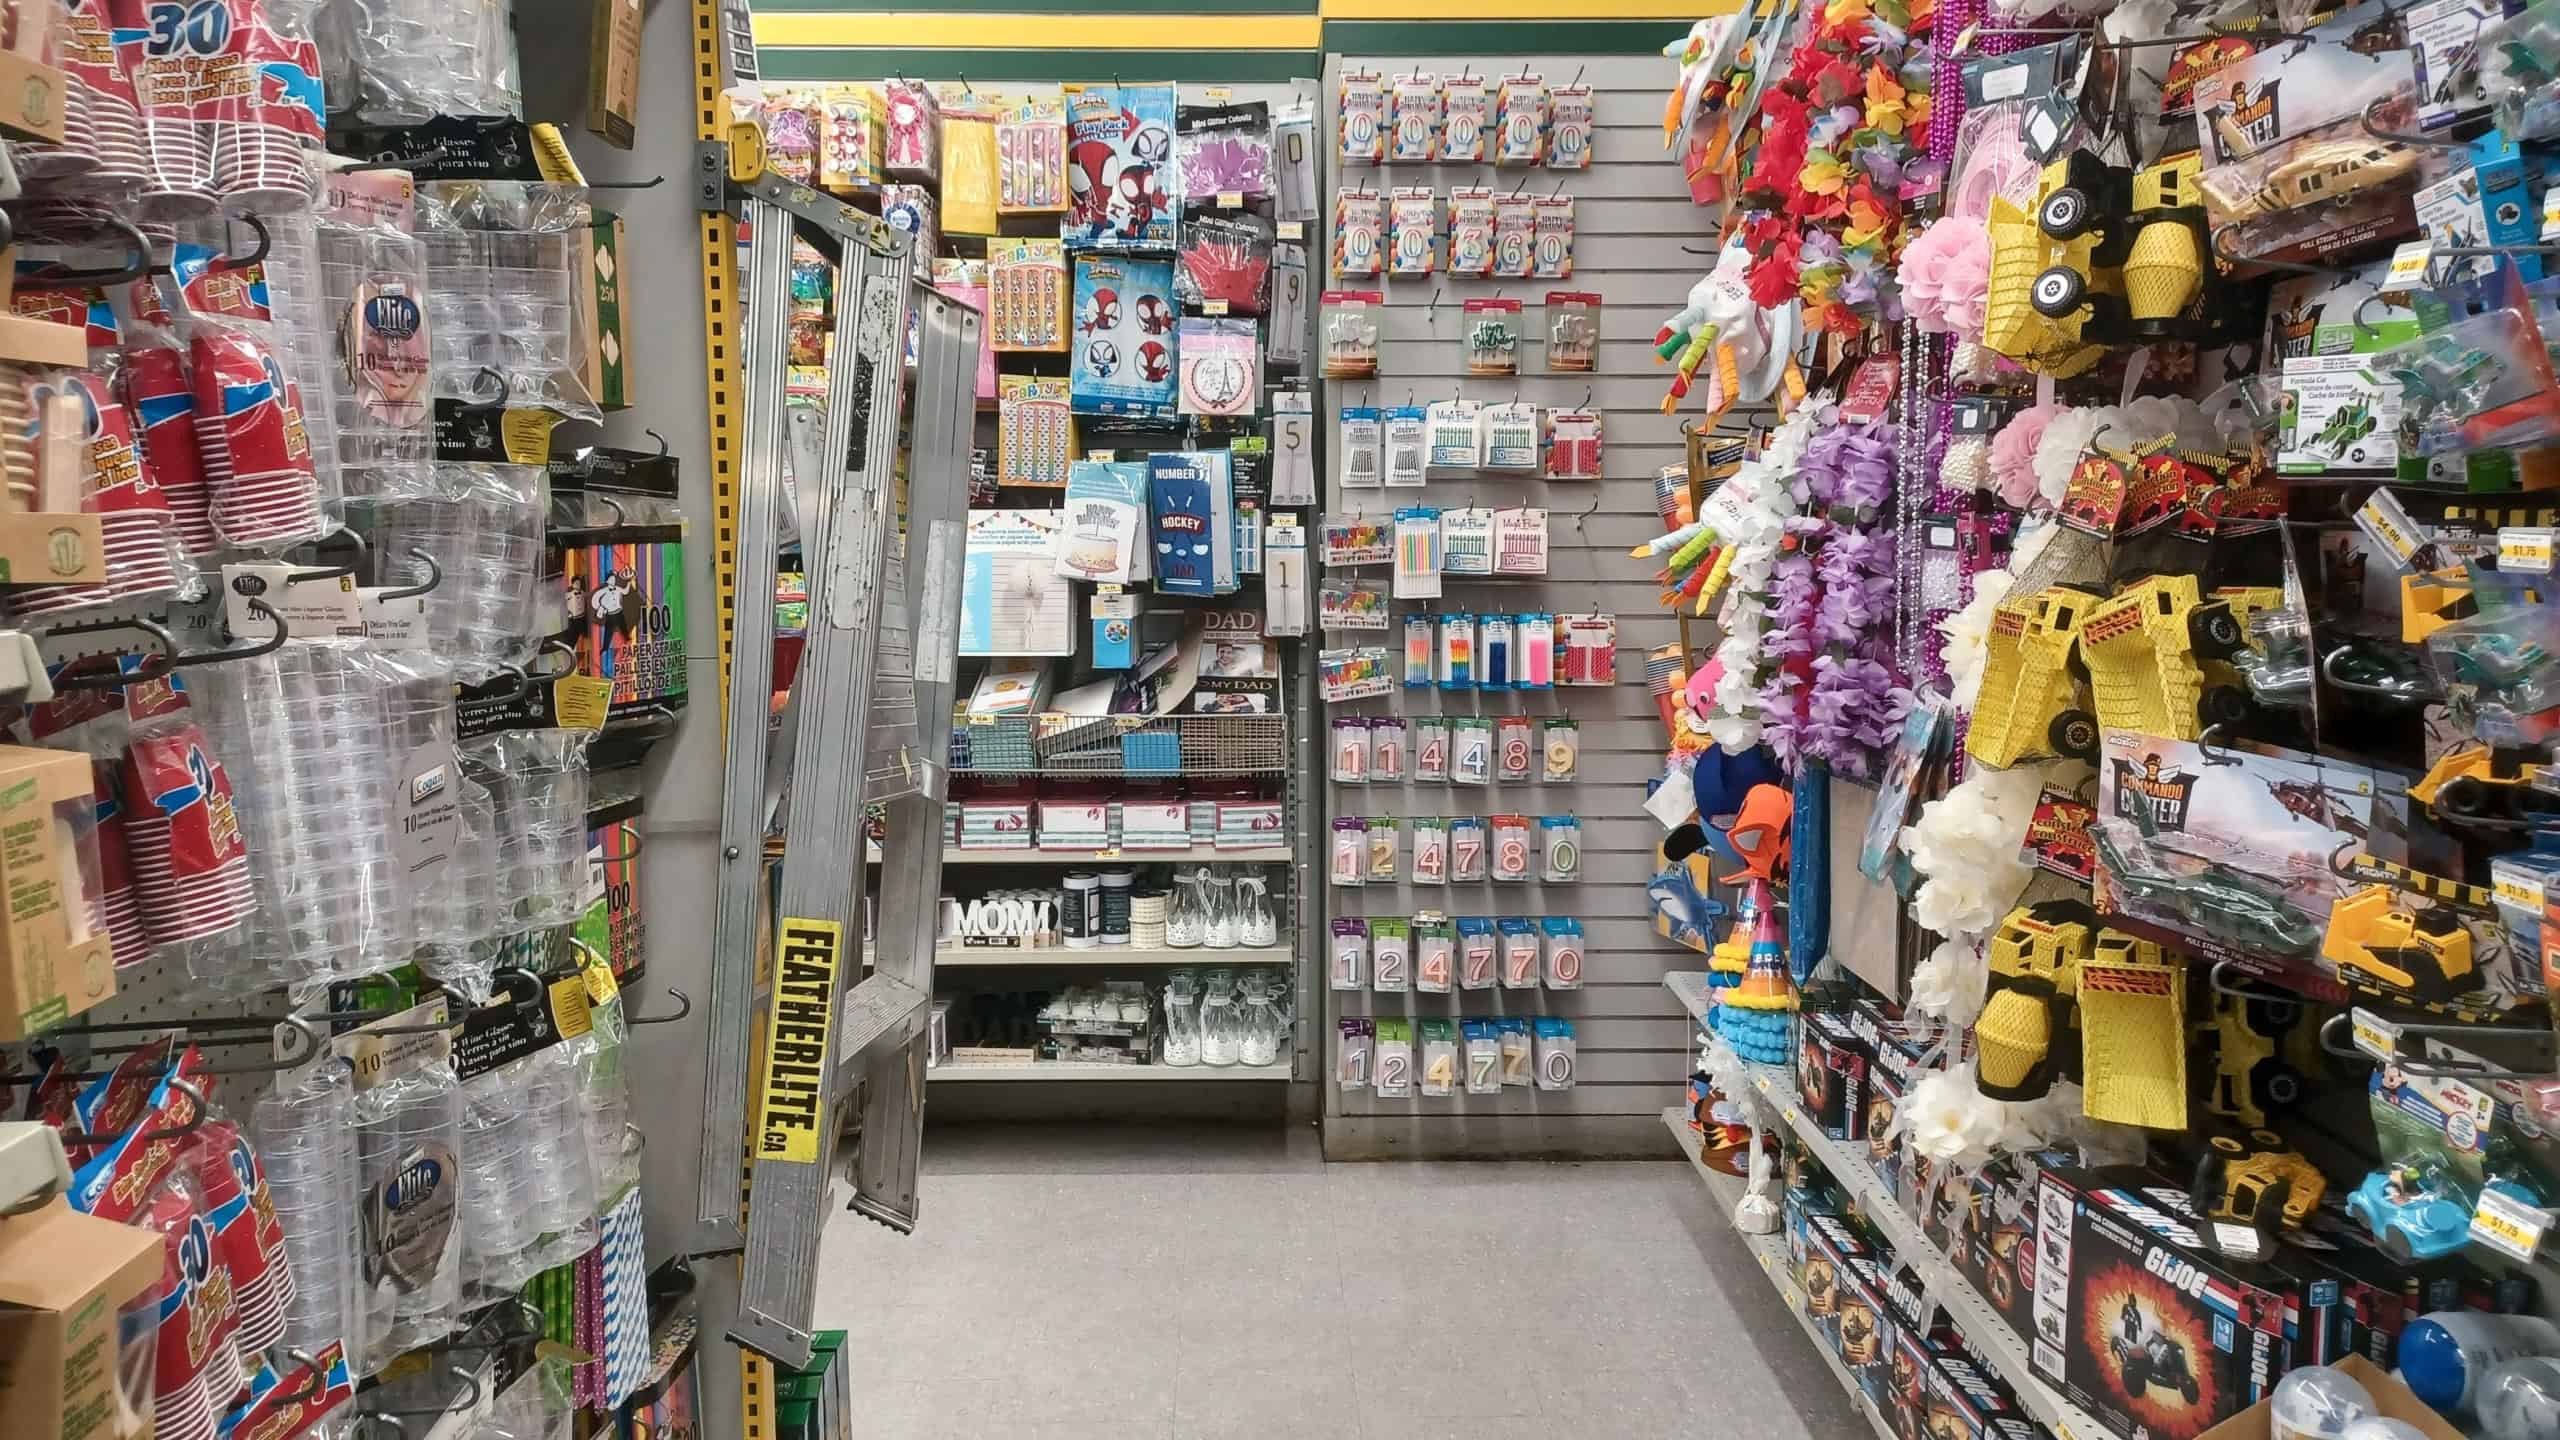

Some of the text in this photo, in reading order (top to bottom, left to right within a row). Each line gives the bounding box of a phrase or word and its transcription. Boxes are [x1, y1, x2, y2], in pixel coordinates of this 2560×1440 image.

[147, 1, 230, 55] 30
[139, 75, 186, 90] erres
[1074, 119, 1129, 135] Play Pack
[1352, 113, 1373, 143] 0
[1404, 114, 1424, 144] 0
[1455, 115, 1475, 144] 0
[1513, 115, 1533, 144] 0
[1560, 125, 1581, 153] 0
[1352, 228, 1372, 258] 0
[1404, 229, 1424, 258] 0
[1502, 233, 1522, 264] 6
[1542, 235, 1562, 264] 0
[376, 297, 412, 329] Elite
[357, 353, 376, 371] 10
[1286, 421, 1300, 449] 5
[1155, 468, 1196, 480] NUMBER
[1161, 515, 1201, 531] HOCKEY
[2512, 544, 2537, 557] $1.75
[187, 614, 207, 630] 20
[640, 604, 672, 635] 100
[1205, 611, 1256, 630] DAD
[622, 643, 652, 658] PAPER
[613, 658, 652, 677] PAILLES
[613, 677, 657, 695] PITILLOS
[1211, 680, 1273, 690] MY DAD
[1344, 742, 1361, 778] 1
[1378, 742, 1396, 778] 1
[1420, 739, 1443, 772] 4
[1462, 742, 1486, 776] 4
[1504, 738, 1528, 772] 8
[1547, 741, 1575, 774] 9
[2121, 771, 2185, 800] COMMANDO
[2120, 788, 2181, 824] COTER
[402, 816, 418, 834] 10
[1371, 844, 1393, 874] 2
[1418, 842, 1442, 877] 4
[1456, 841, 1481, 874] 7
[1502, 839, 1526, 874] 8
[1552, 839, 1577, 874] 0
[1340, 947, 1358, 983] 1
[1379, 950, 1402, 983] 2
[1424, 950, 1448, 985] 4
[1468, 946, 1493, 983] 7
[1511, 946, 1536, 983] 7
[1554, 947, 1581, 981] 0
[359, 1054, 381, 1075] 10
[1350, 1048, 1368, 1083] 1
[1384, 1055, 1407, 1088] 2
[1427, 1054, 1453, 1092] 4
[1471, 1055, 1497, 1090] 7
[1504, 1047, 1529, 1081] 7
[1546, 1052, 1572, 1083] 0
[398, 1165, 433, 1202] Elite
[2490, 1216, 2519, 1238] $1.75
